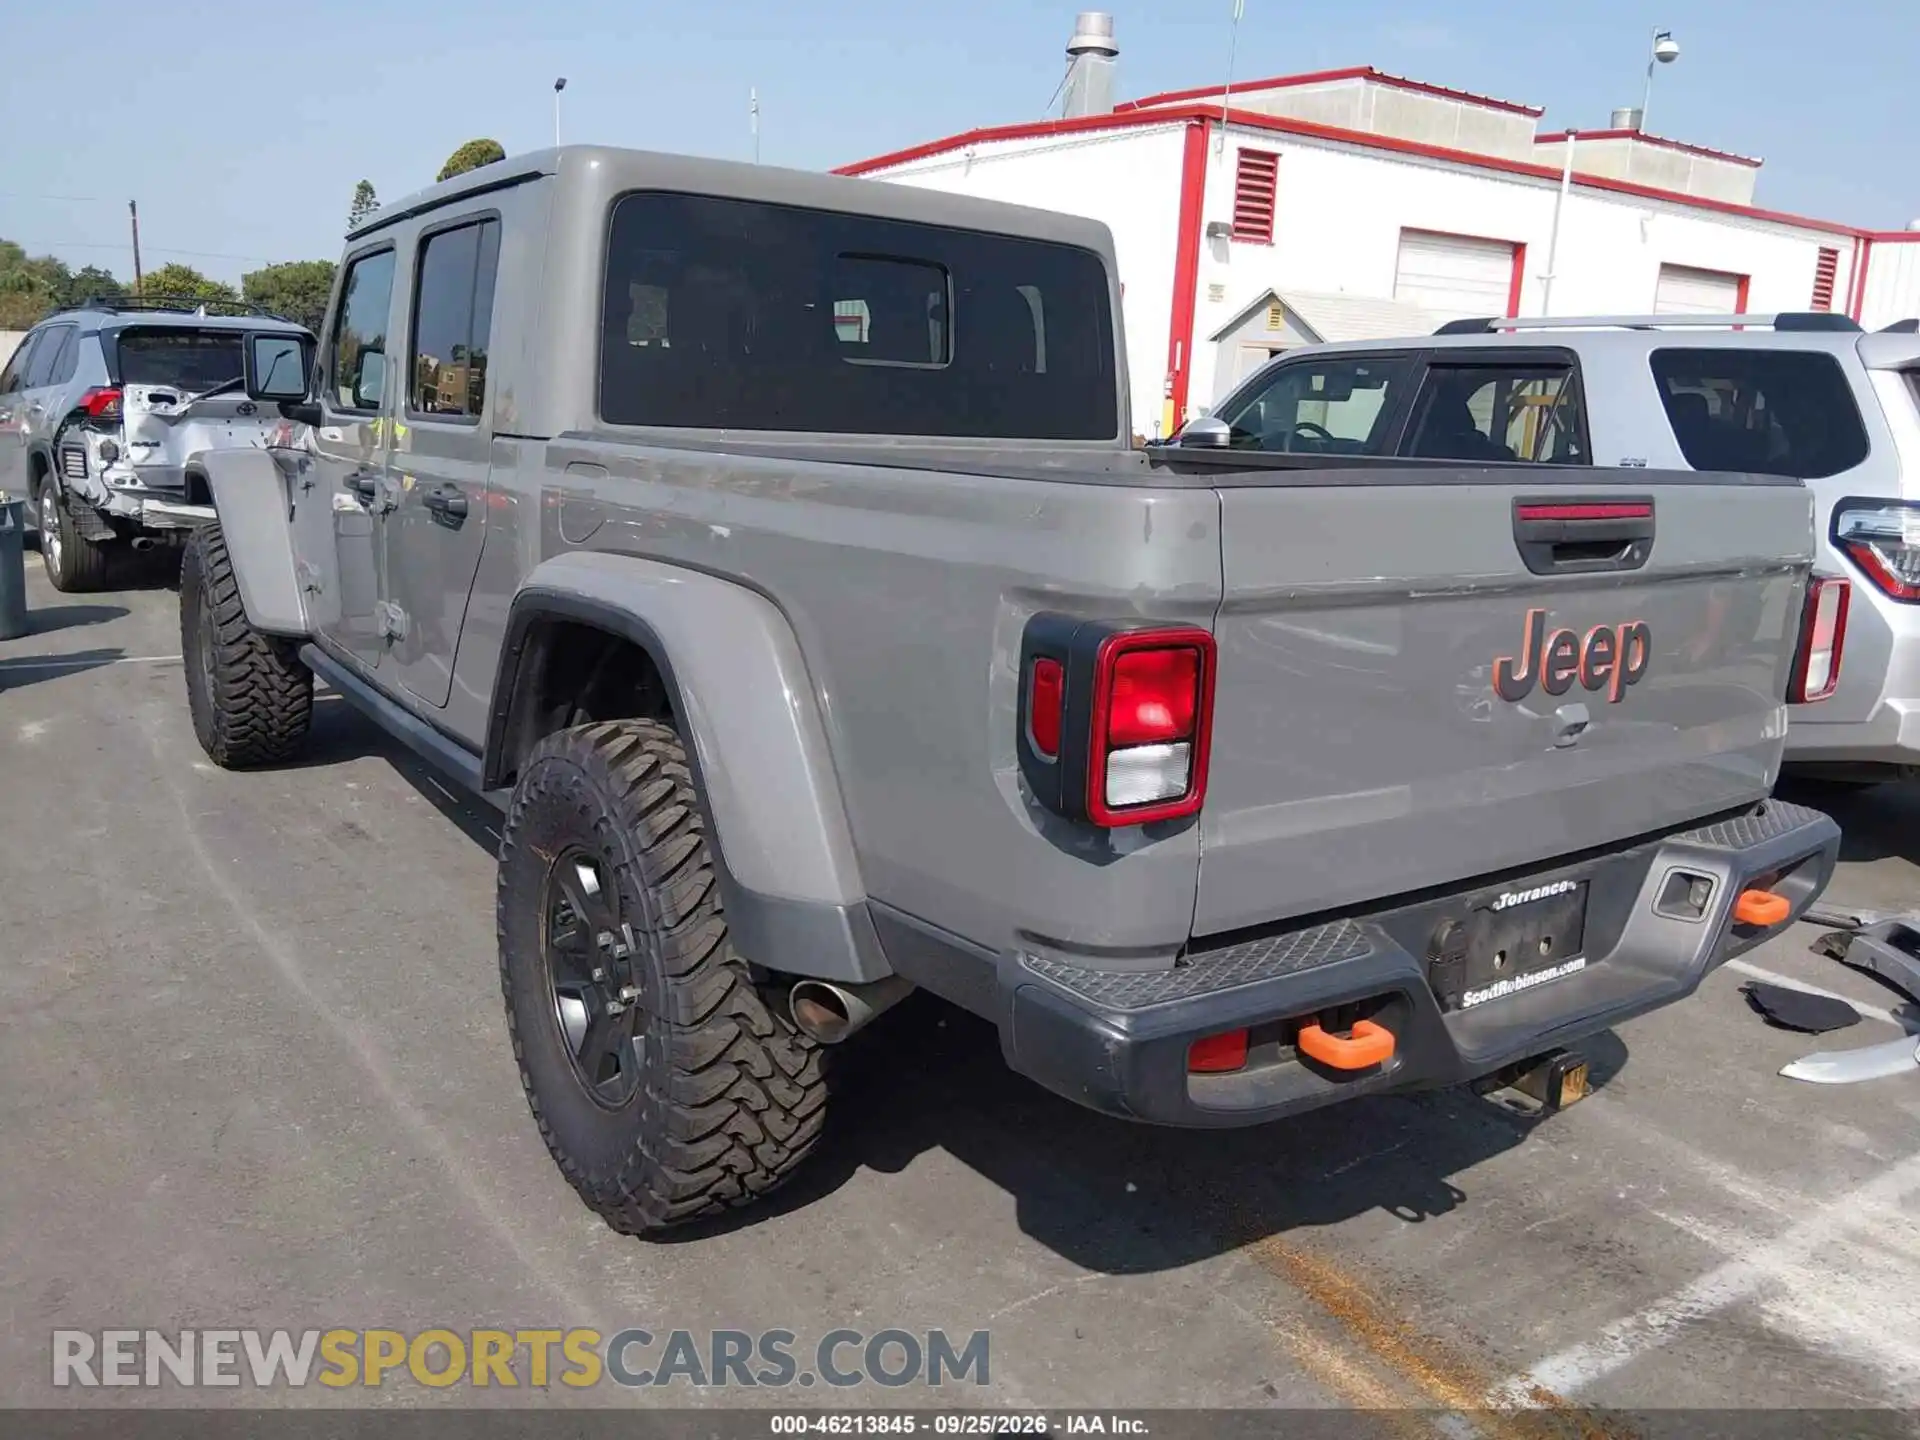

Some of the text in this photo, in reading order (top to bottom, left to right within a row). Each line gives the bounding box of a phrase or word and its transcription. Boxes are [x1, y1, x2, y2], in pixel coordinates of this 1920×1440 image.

[1493, 608, 1651, 703] Jeep
[1498, 881, 1570, 910] Torrance
[1463, 957, 1586, 1007] ScottRobinson.com
